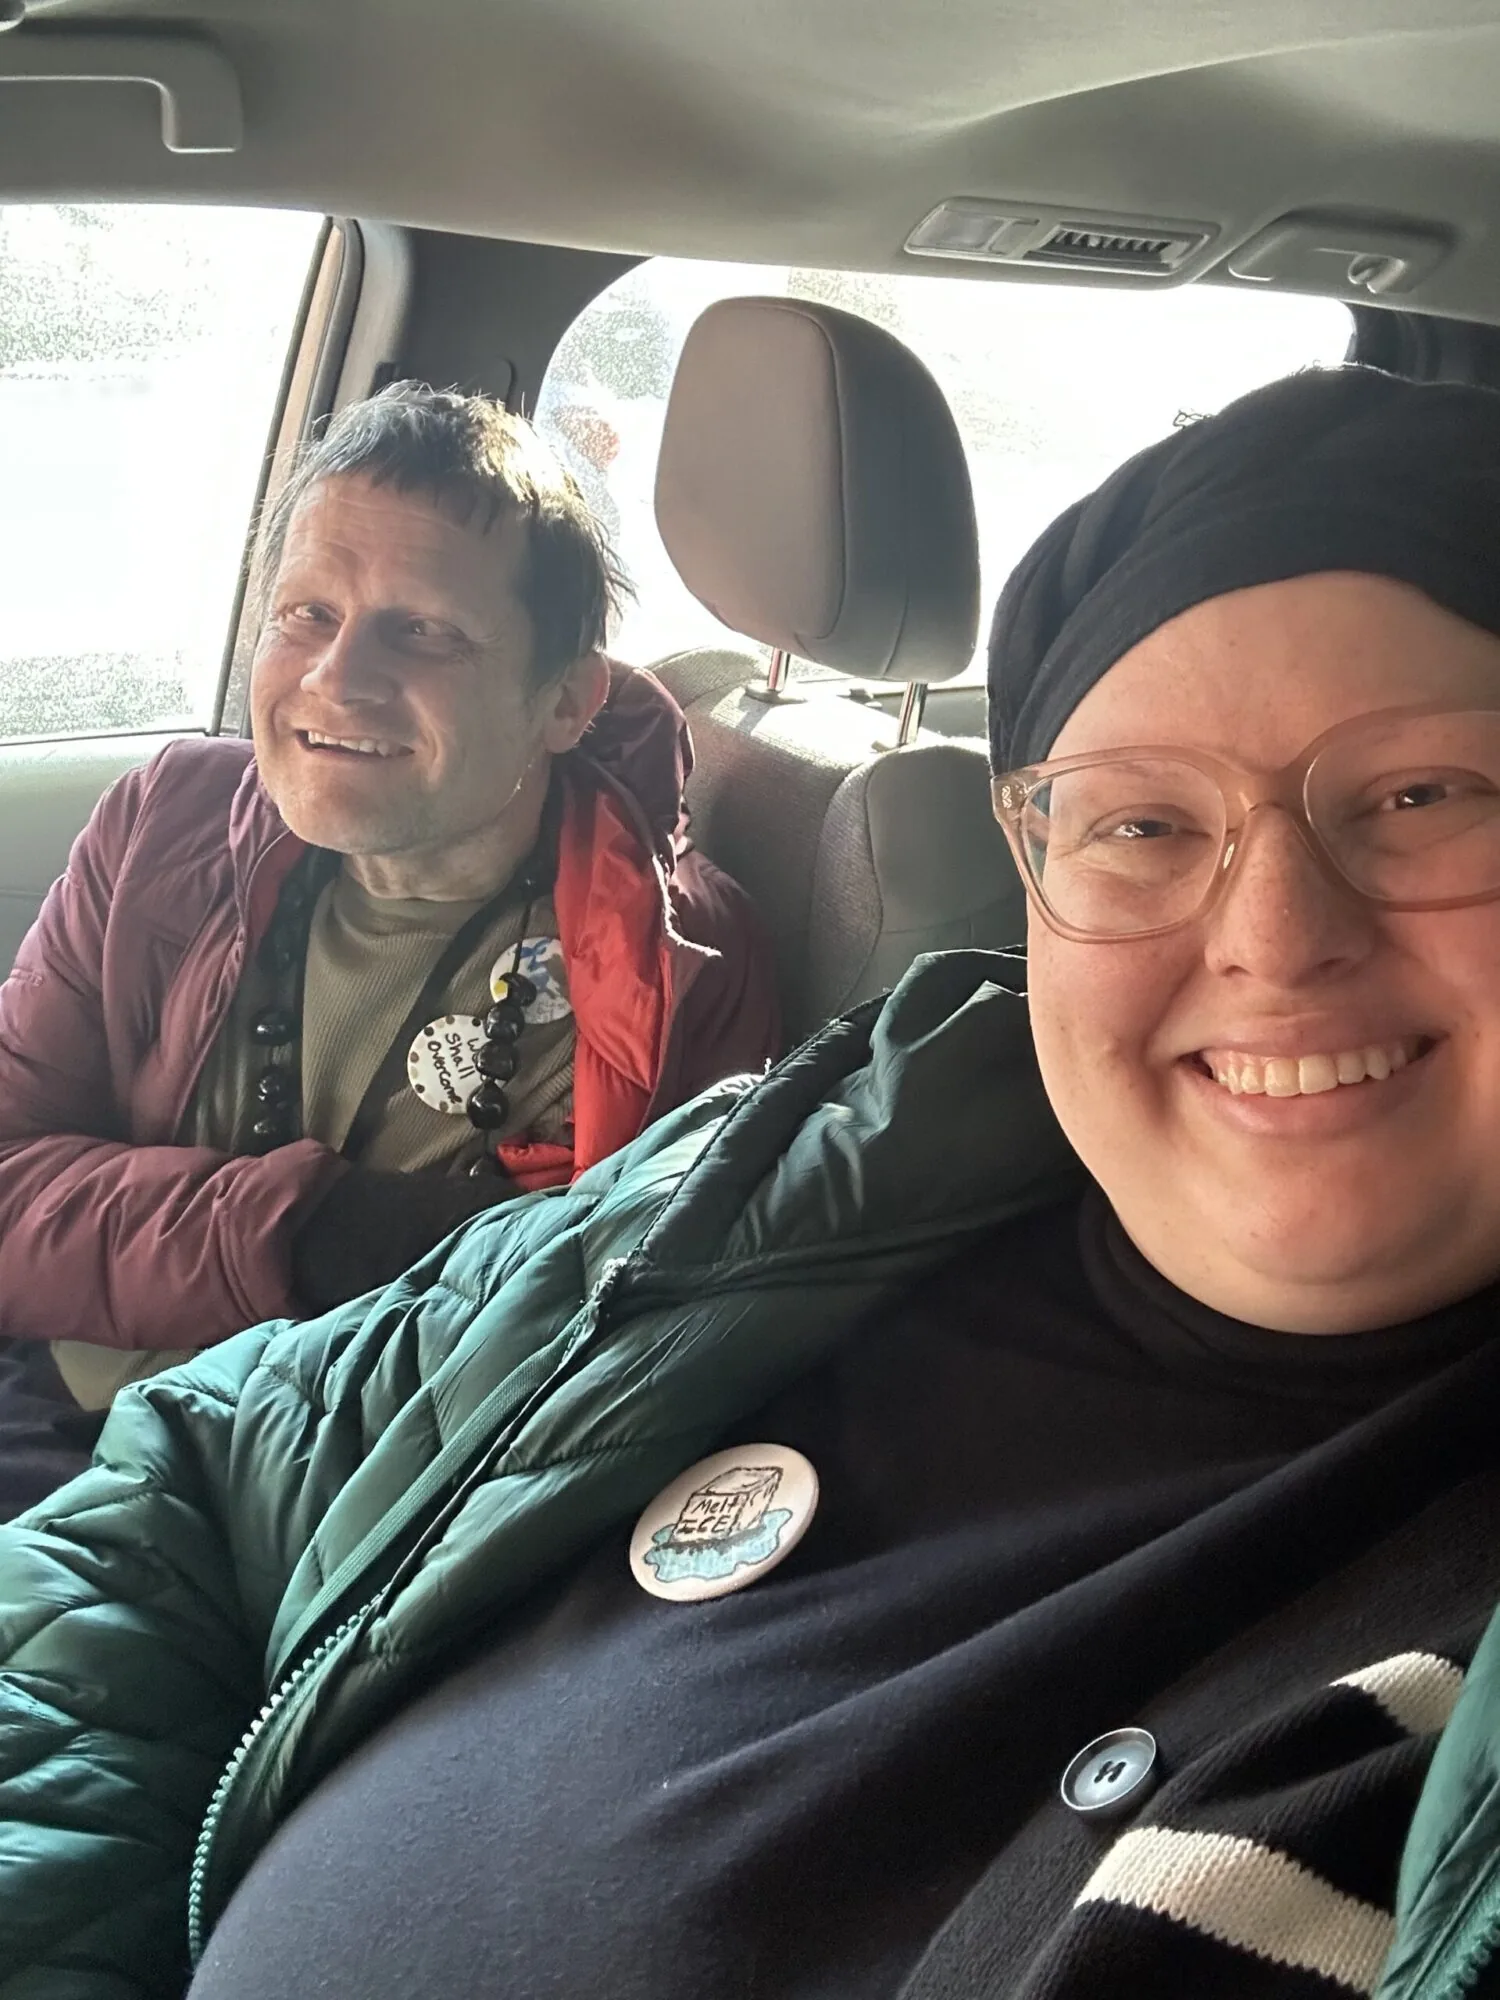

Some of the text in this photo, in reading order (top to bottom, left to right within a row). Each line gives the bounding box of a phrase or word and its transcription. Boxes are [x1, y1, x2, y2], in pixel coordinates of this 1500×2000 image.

[445, 1032, 475, 1080] Shall
[691, 1496, 739, 1514] Melt
[676, 1515, 731, 1534] ICE
